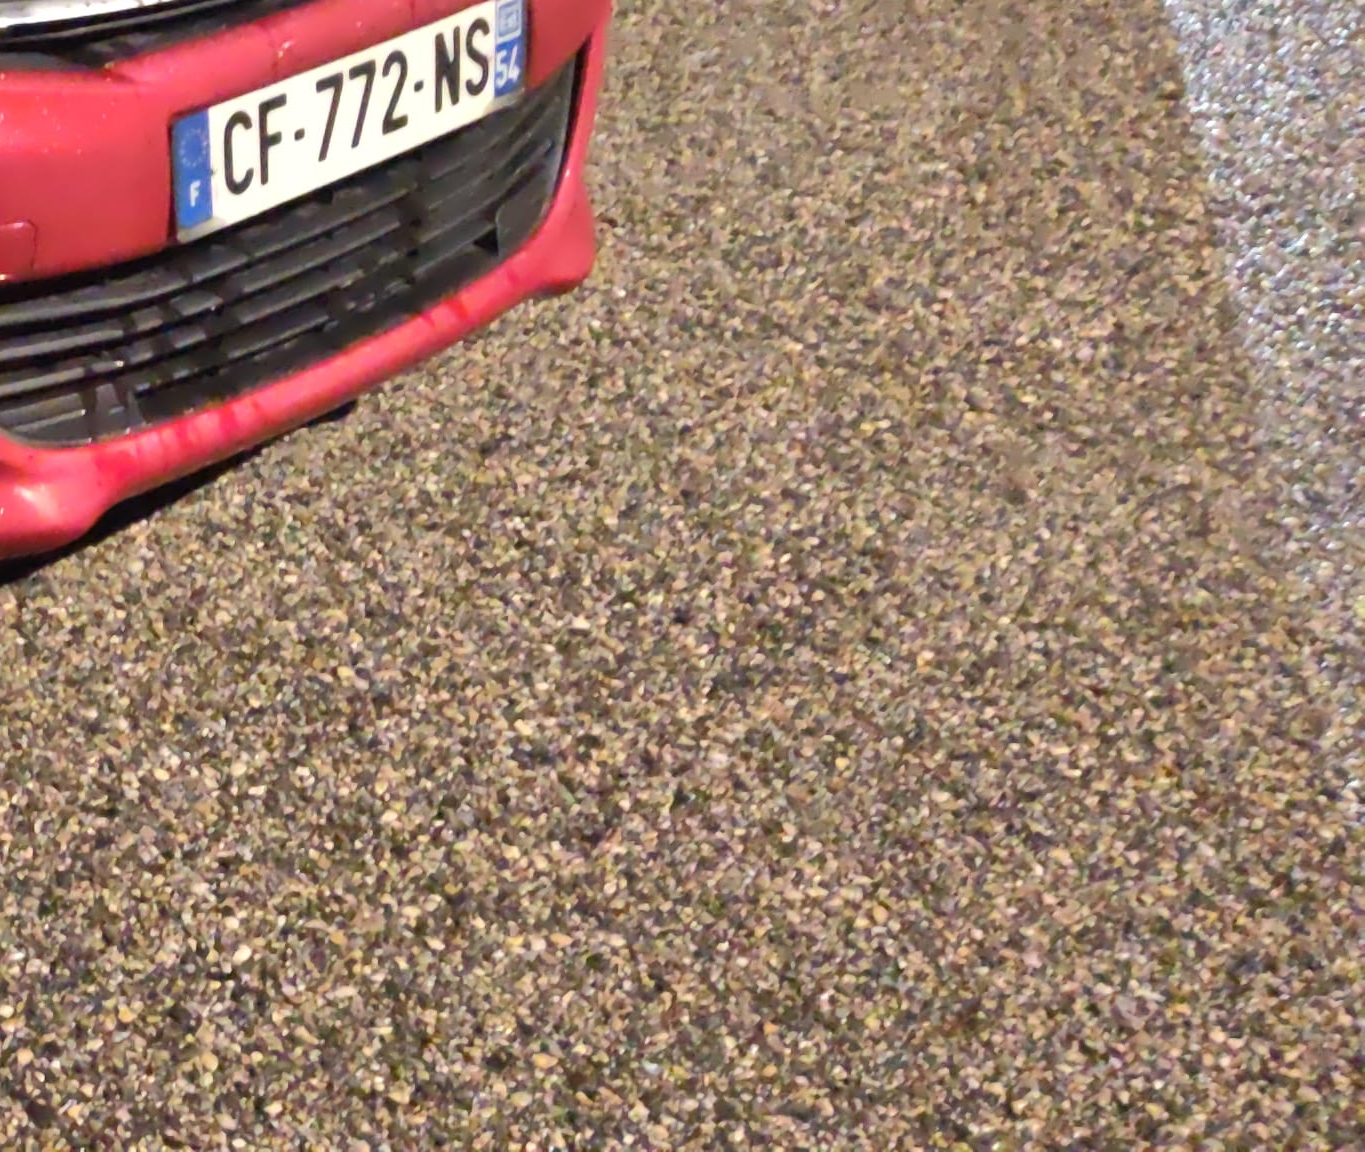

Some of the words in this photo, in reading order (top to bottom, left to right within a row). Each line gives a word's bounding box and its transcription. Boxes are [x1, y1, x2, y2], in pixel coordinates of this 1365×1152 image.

[188, 180, 201, 208] F
[223, 17, 490, 196] CF-772-NS
[495, 44, 520, 89] 54
